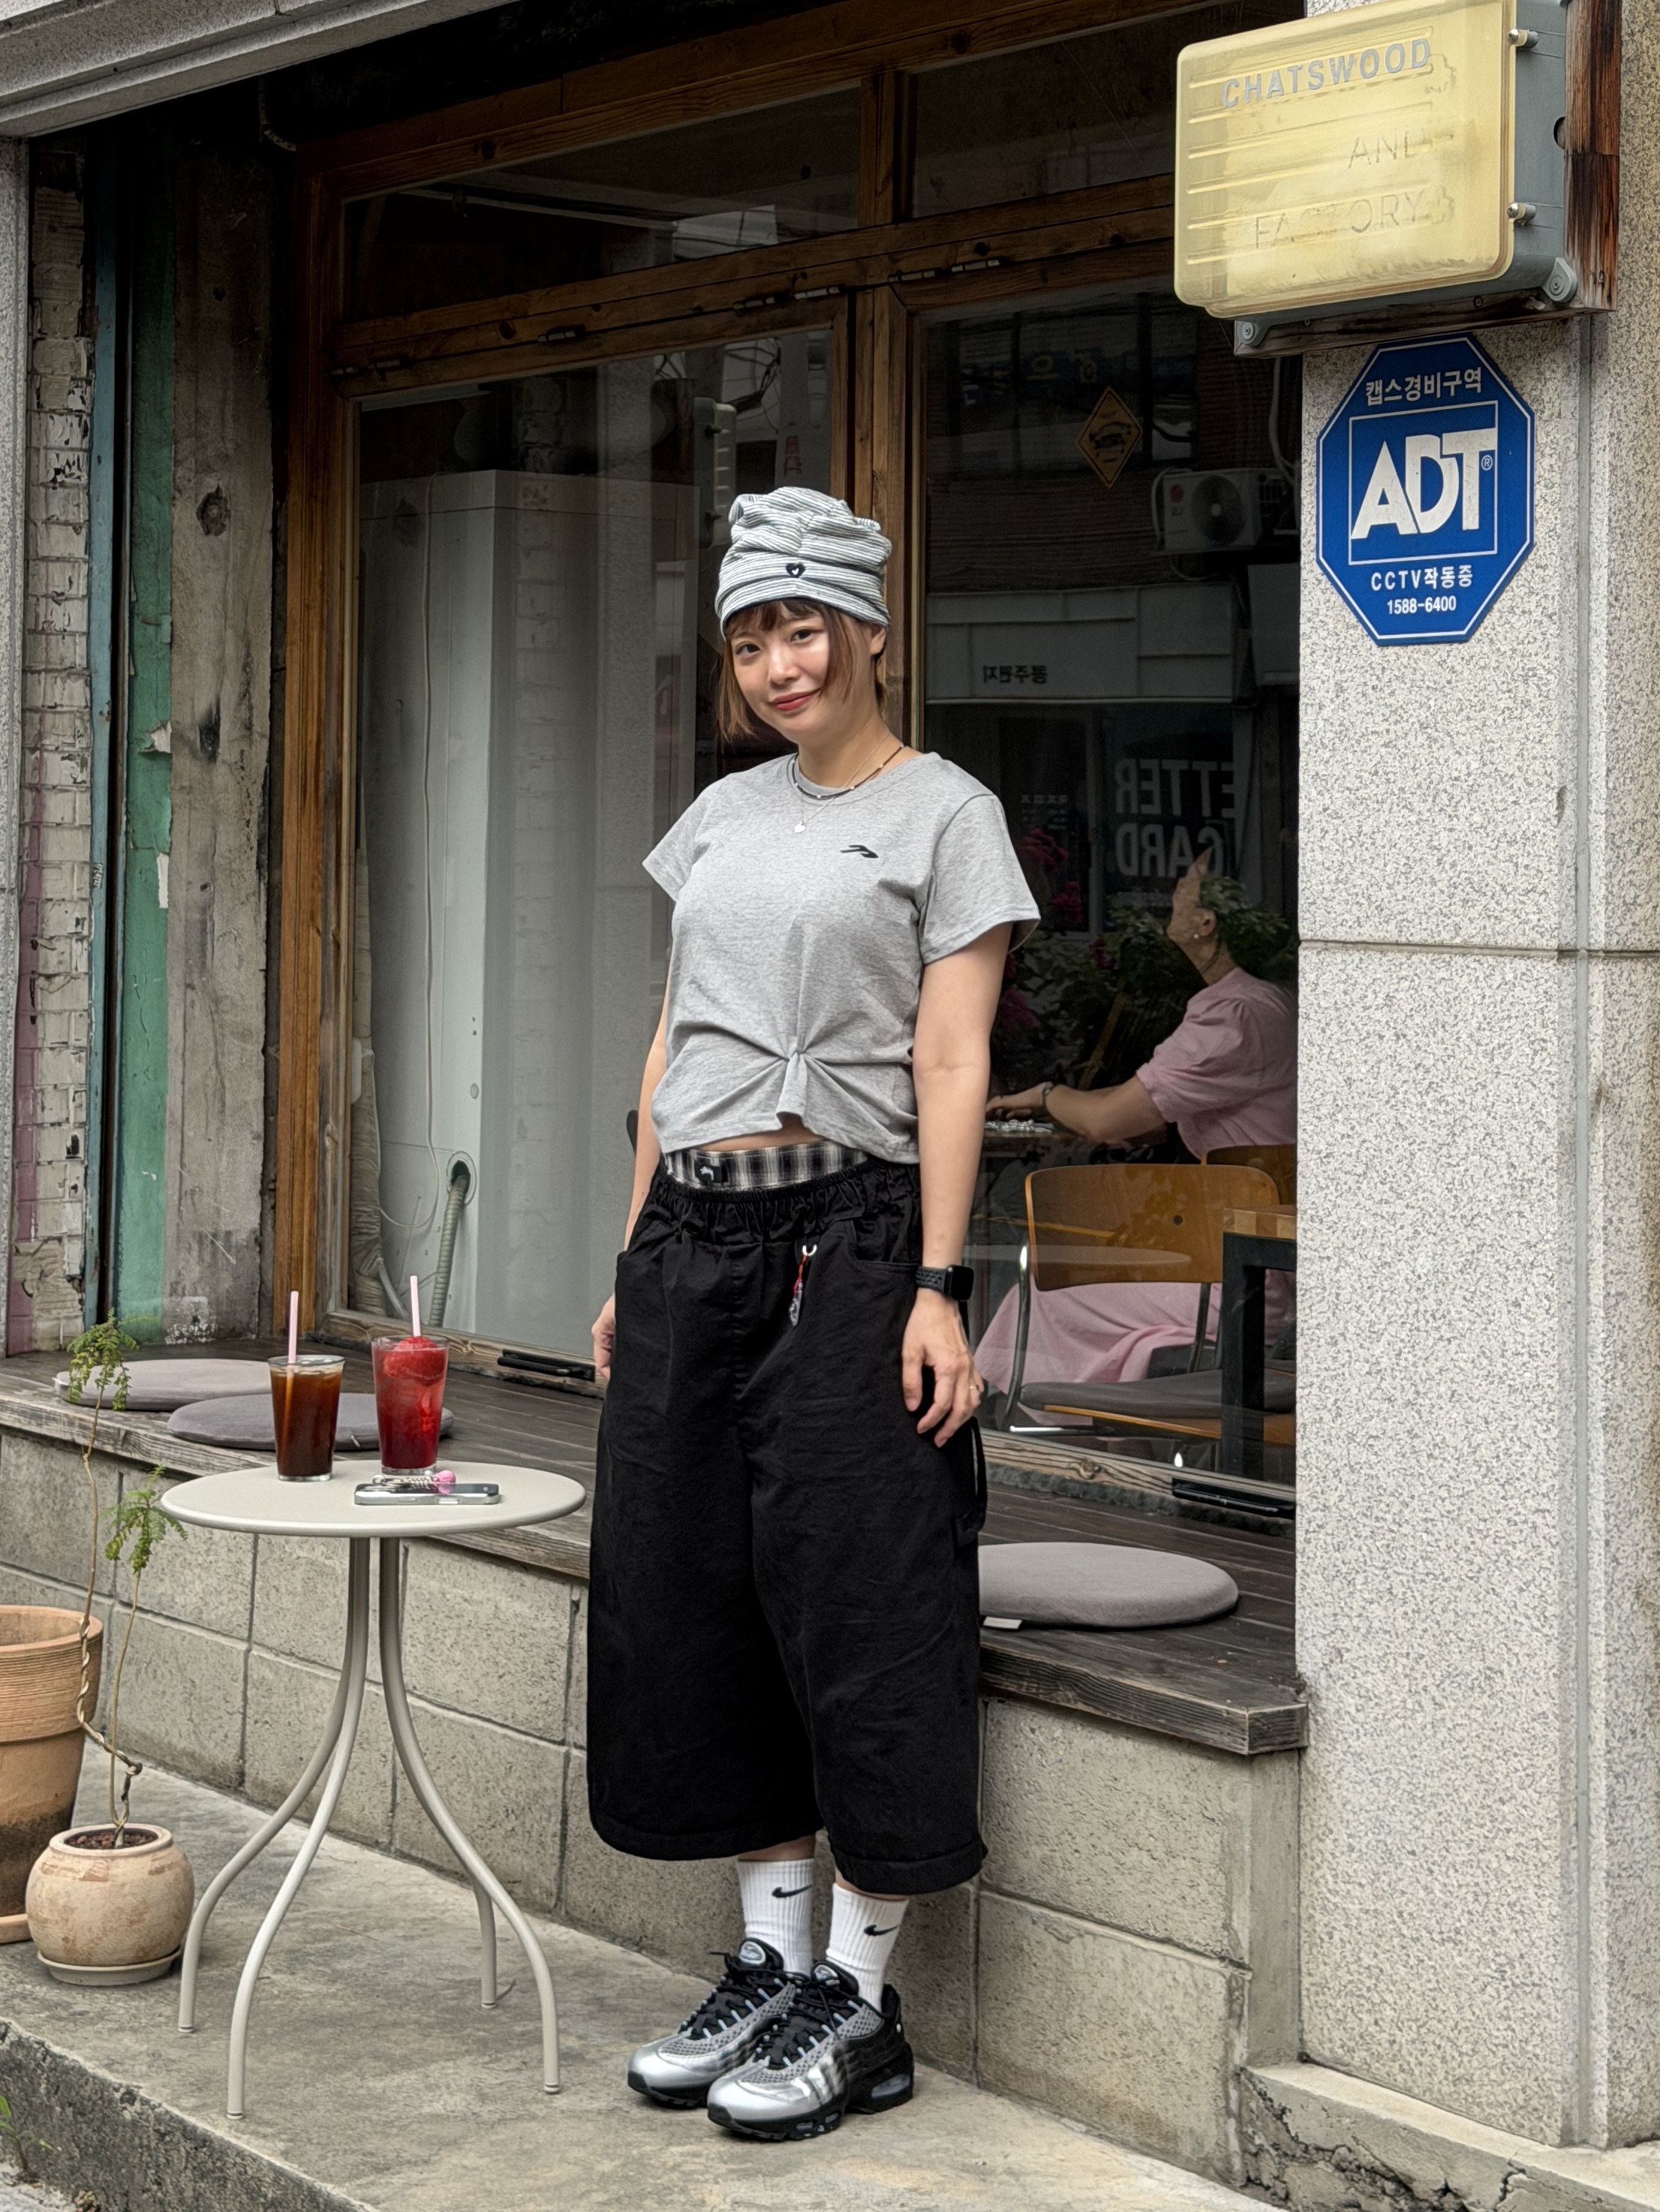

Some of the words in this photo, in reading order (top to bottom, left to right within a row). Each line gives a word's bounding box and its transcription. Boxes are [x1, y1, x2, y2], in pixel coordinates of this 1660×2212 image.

[1222, 38, 1430, 108] CHATSWOOD
[1254, 188, 1426, 249] FAORY
[1364, 366, 1483, 406] 캡스경비구역
[1386, 594, 1457, 615] 1588-6400
